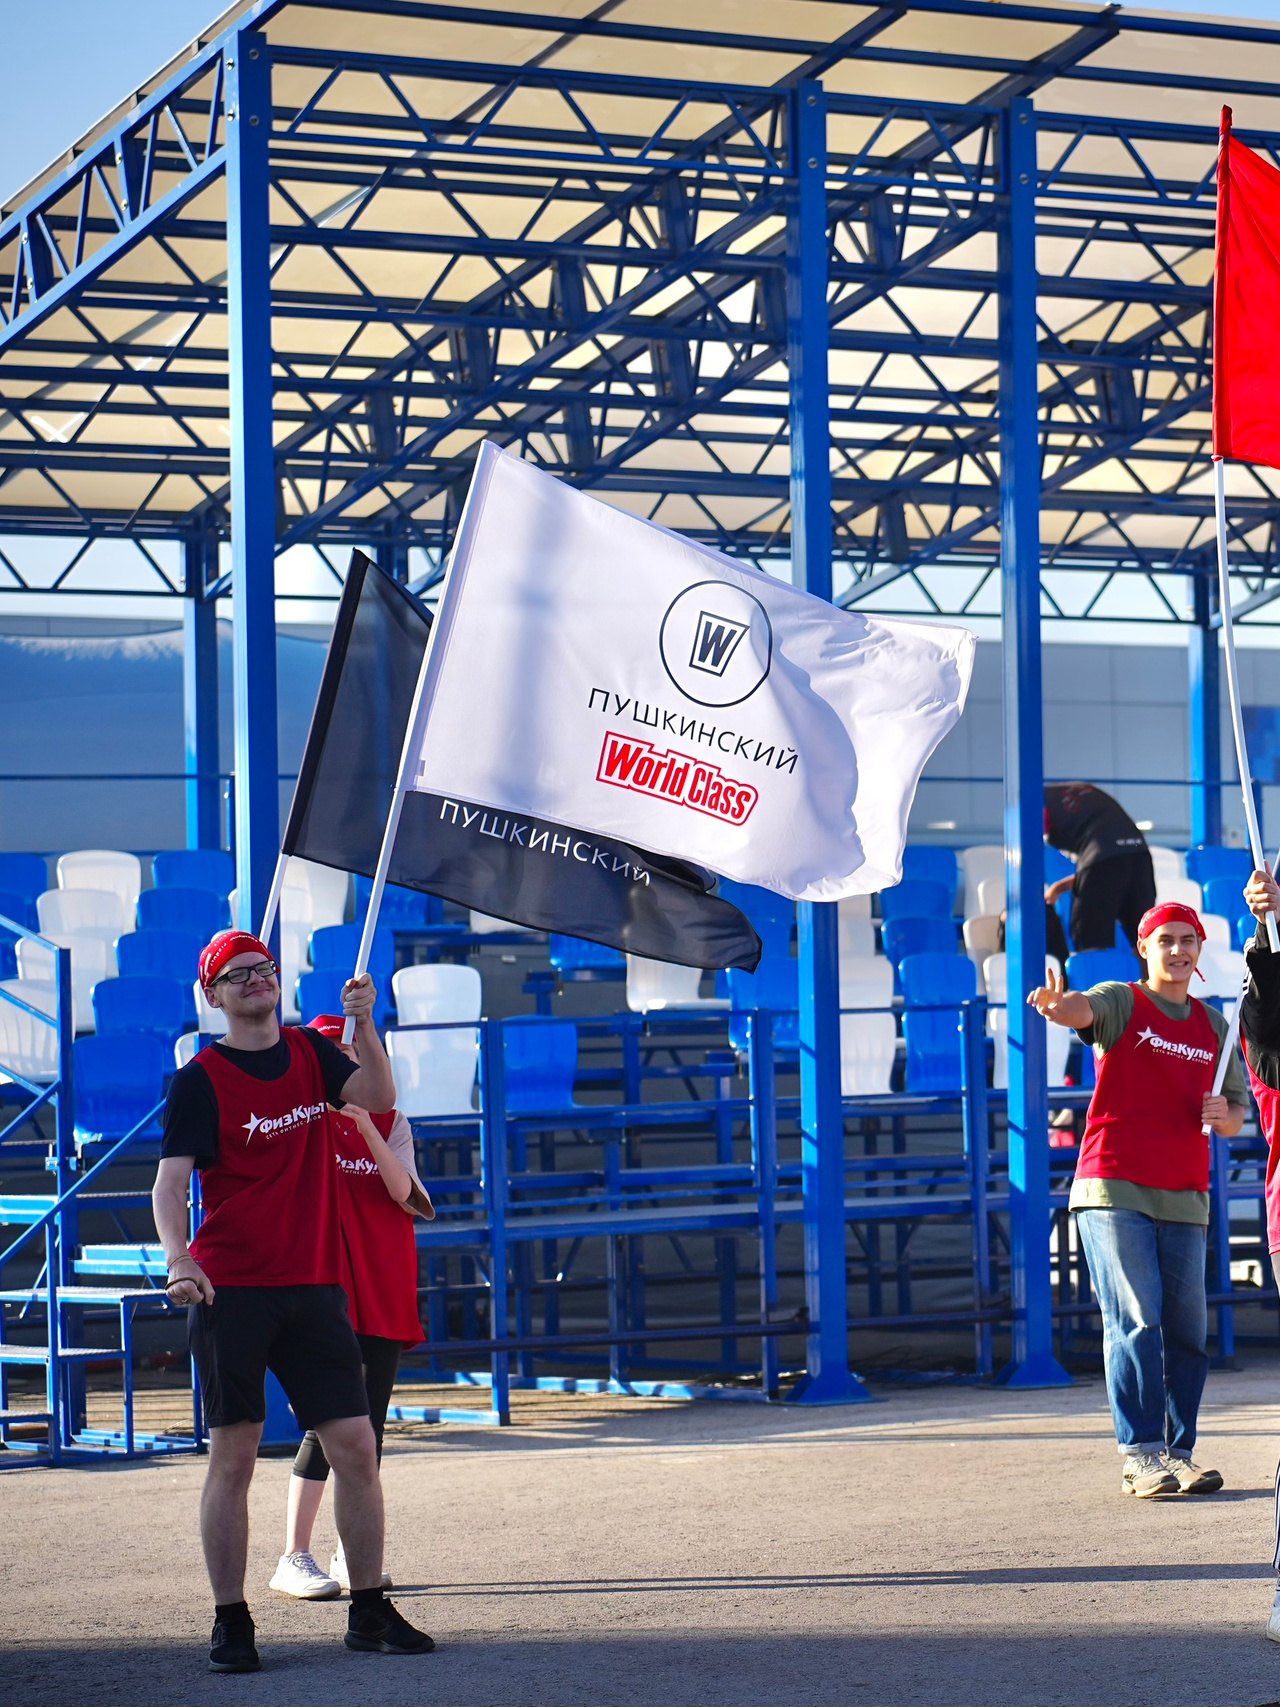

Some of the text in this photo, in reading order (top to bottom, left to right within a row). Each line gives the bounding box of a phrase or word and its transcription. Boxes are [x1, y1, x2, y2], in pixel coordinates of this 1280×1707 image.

[588, 687, 799, 775] ПУШКИНСКИЙ
[604, 739, 752, 820] World Class
[439, 799, 651, 887] ПУШКИНСКИЙ
[1149, 1036, 1214, 1062] ФизКульт
